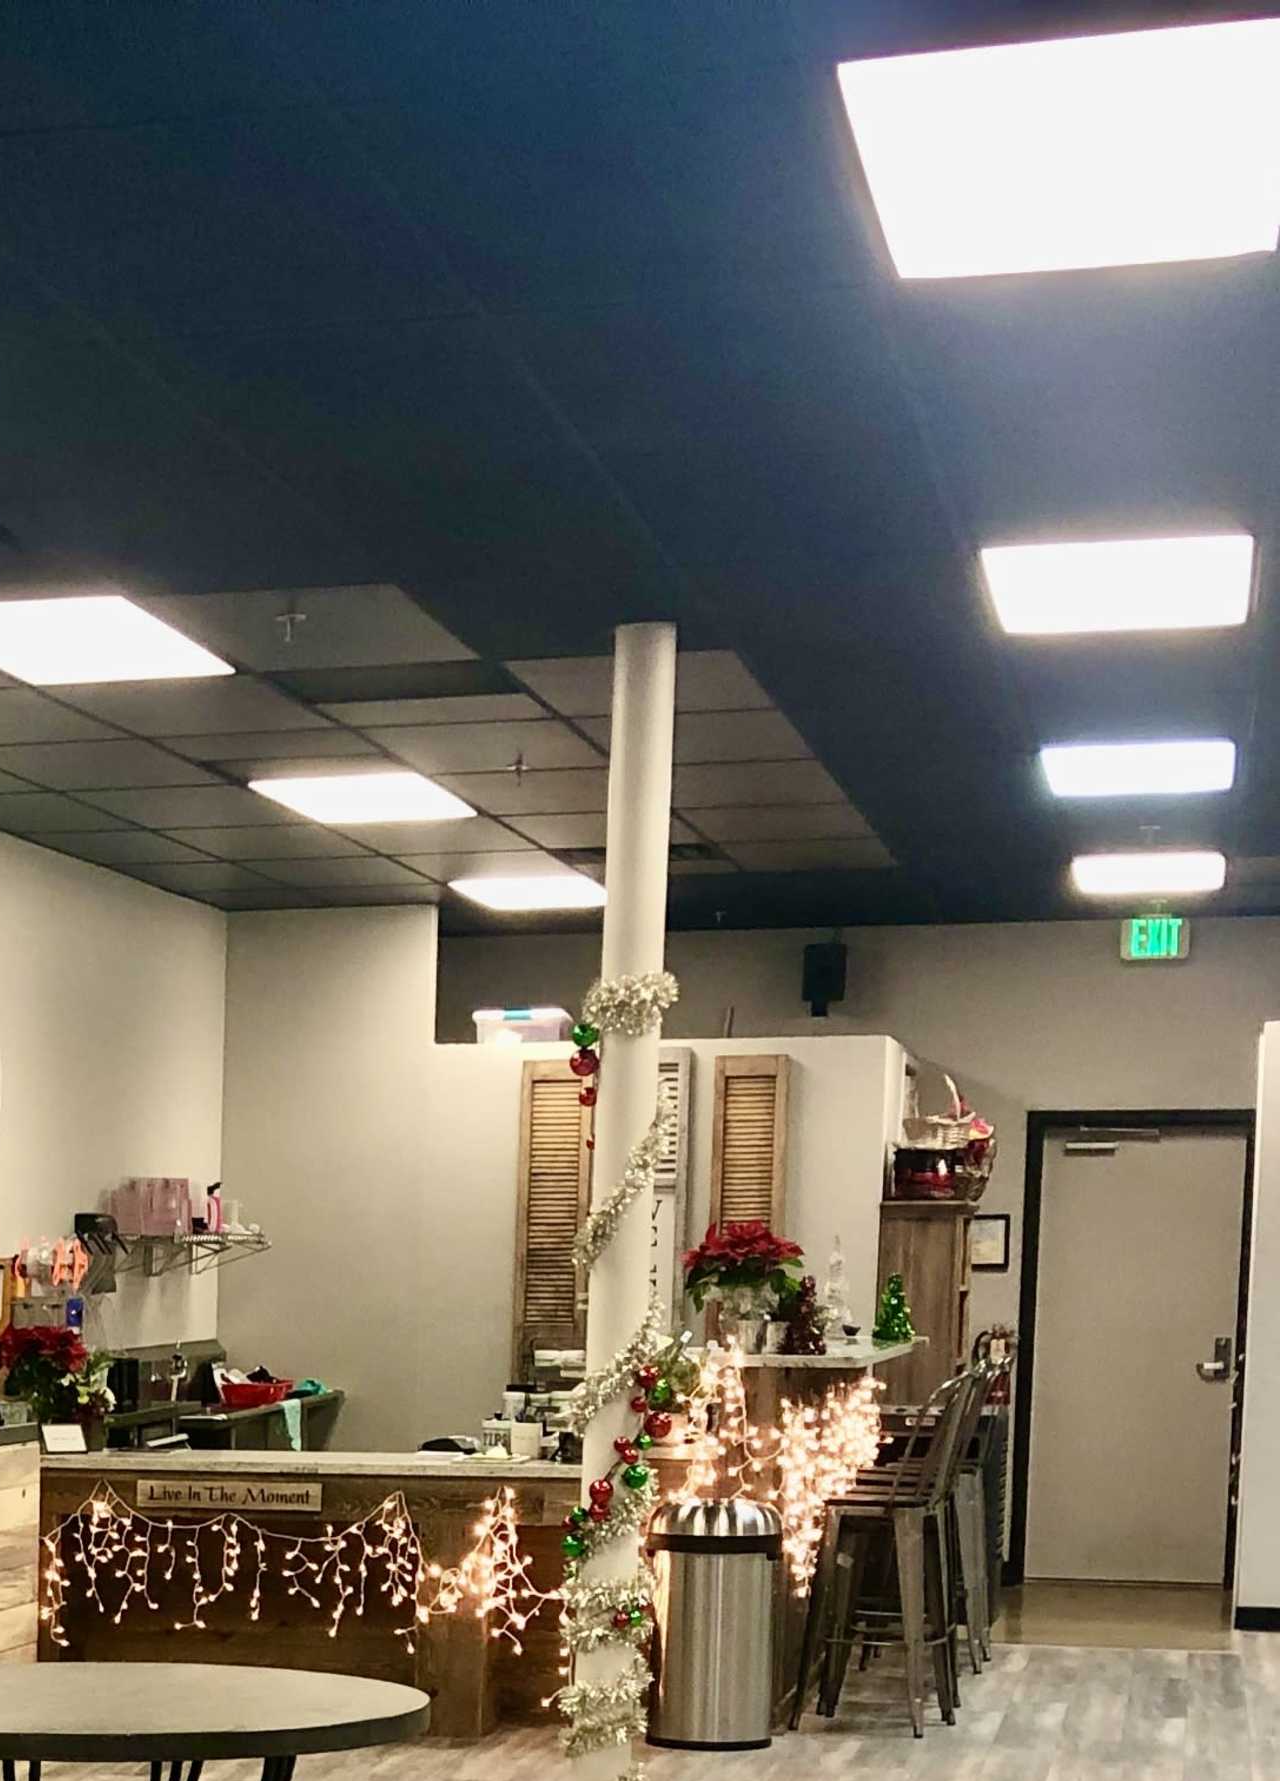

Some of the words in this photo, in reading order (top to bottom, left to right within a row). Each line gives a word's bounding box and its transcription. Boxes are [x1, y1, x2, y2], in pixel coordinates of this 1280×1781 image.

[1130, 918, 1183, 957] EXIT
[149, 1485, 181, 1501] Live
[188, 1484, 201, 1502] In
[204, 1486, 236, 1503] The
[242, 1488, 311, 1505] Moment
